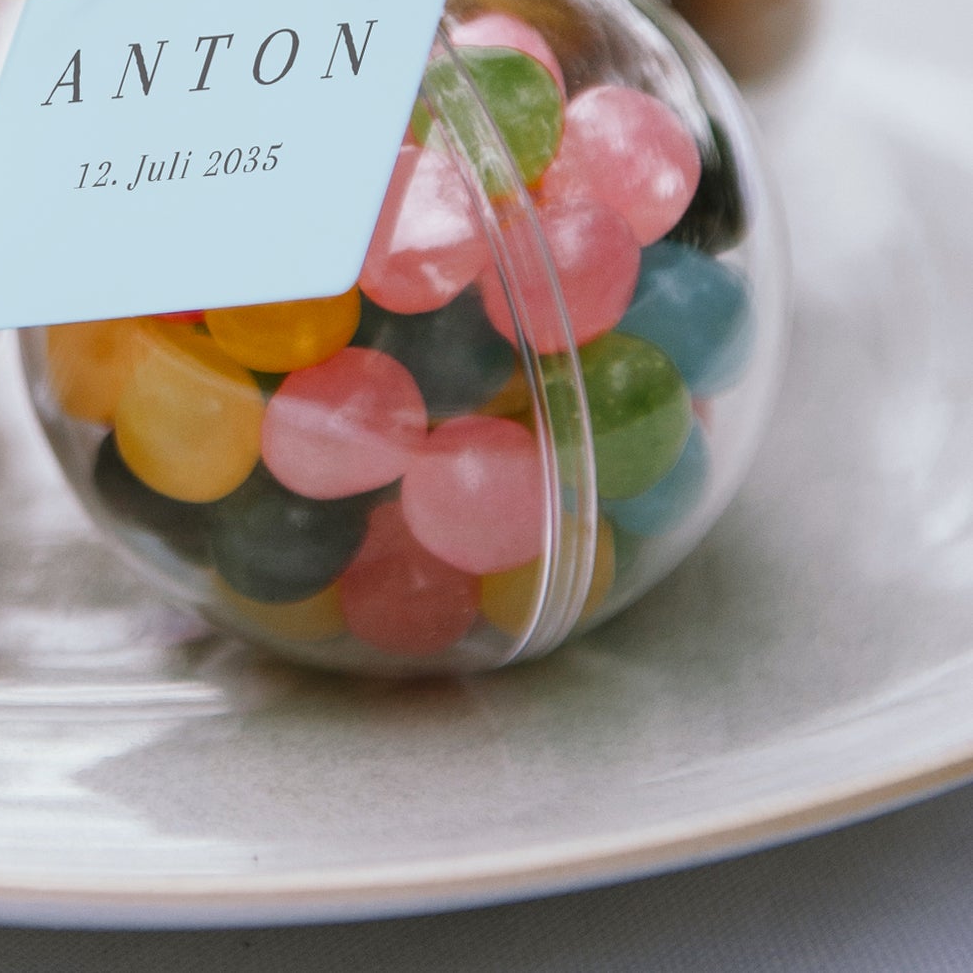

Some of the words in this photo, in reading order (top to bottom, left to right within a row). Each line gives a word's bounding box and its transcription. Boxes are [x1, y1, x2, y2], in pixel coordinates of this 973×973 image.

[40, 19, 379, 106] ANTON
[74, 161, 118, 190] 12.
[127, 151, 193, 191] Juli
[203, 142, 284, 178] 2035
